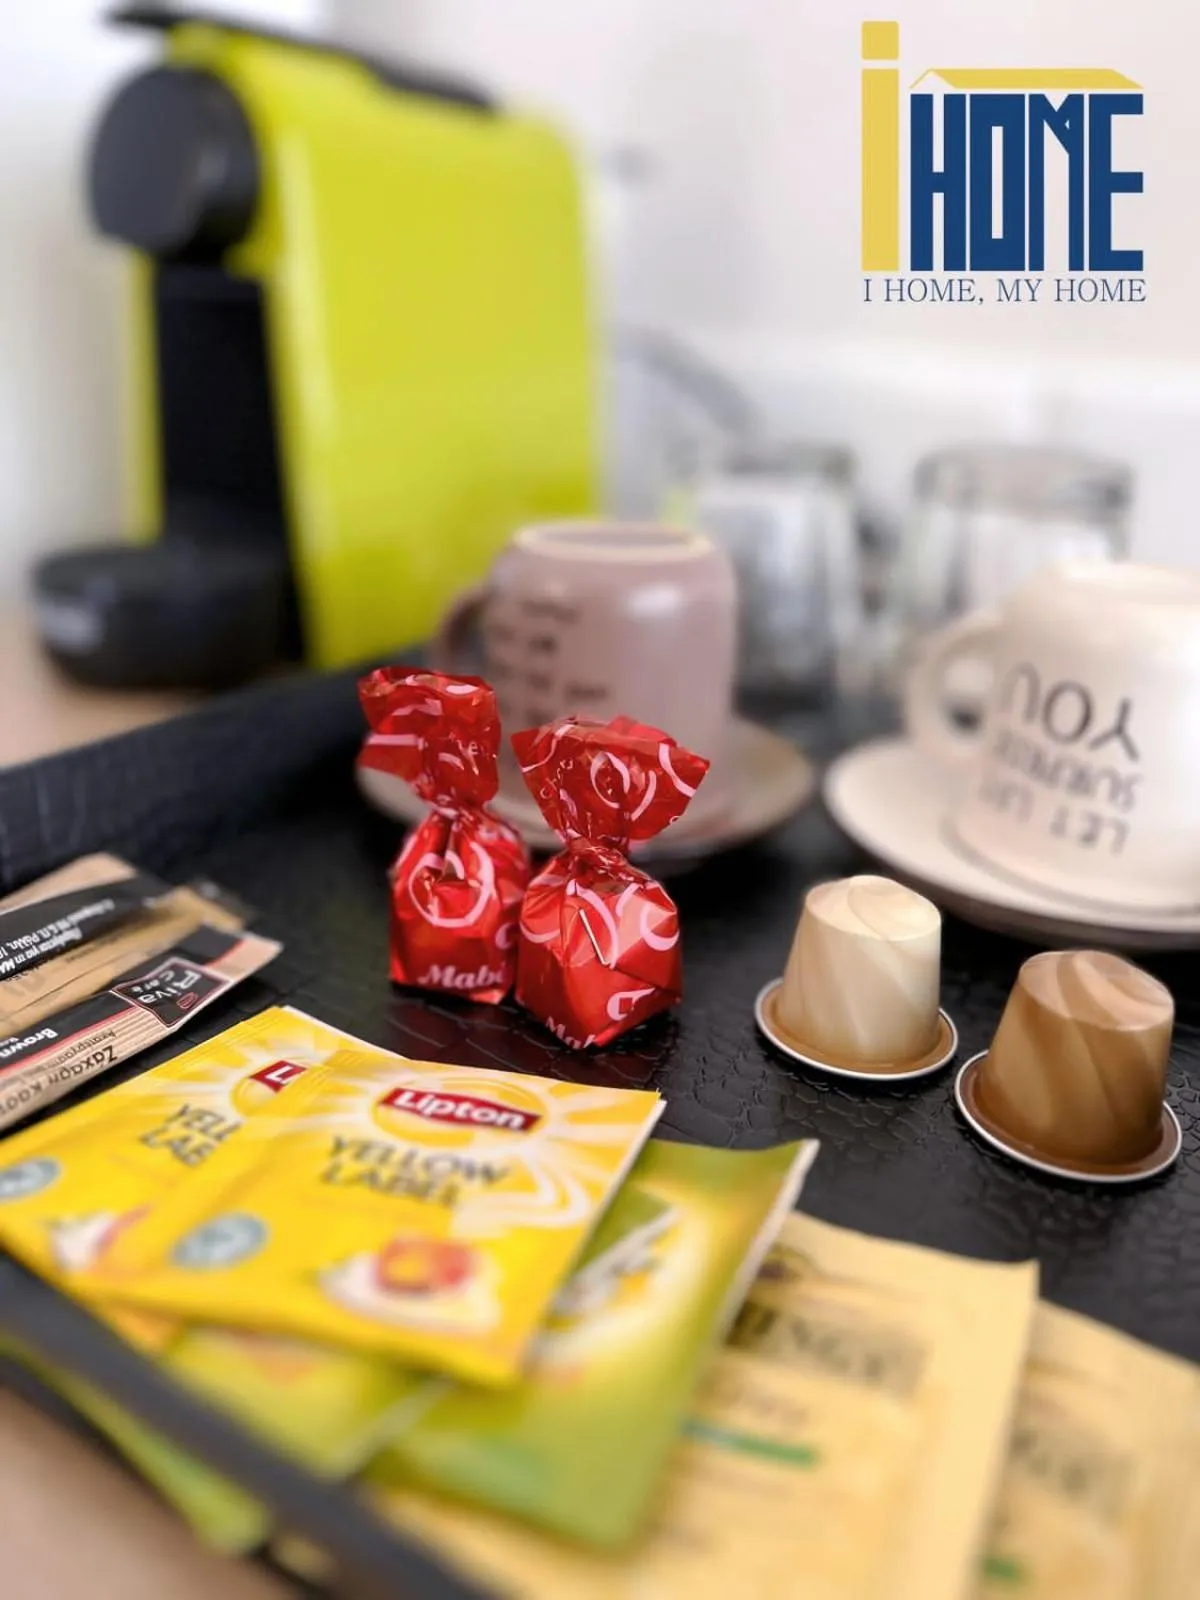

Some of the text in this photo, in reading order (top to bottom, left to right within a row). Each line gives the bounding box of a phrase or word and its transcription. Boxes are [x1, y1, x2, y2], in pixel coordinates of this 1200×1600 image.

[137, 969, 202, 1004] Riva
[0, 1027, 59, 1058] Brown
[47, 1044, 118, 1085] Ζάχαρη
[394, 1091, 526, 1129] Lipton
[329, 1134, 511, 1184] YELLOW
[319, 1160, 460, 1208] LABEL
